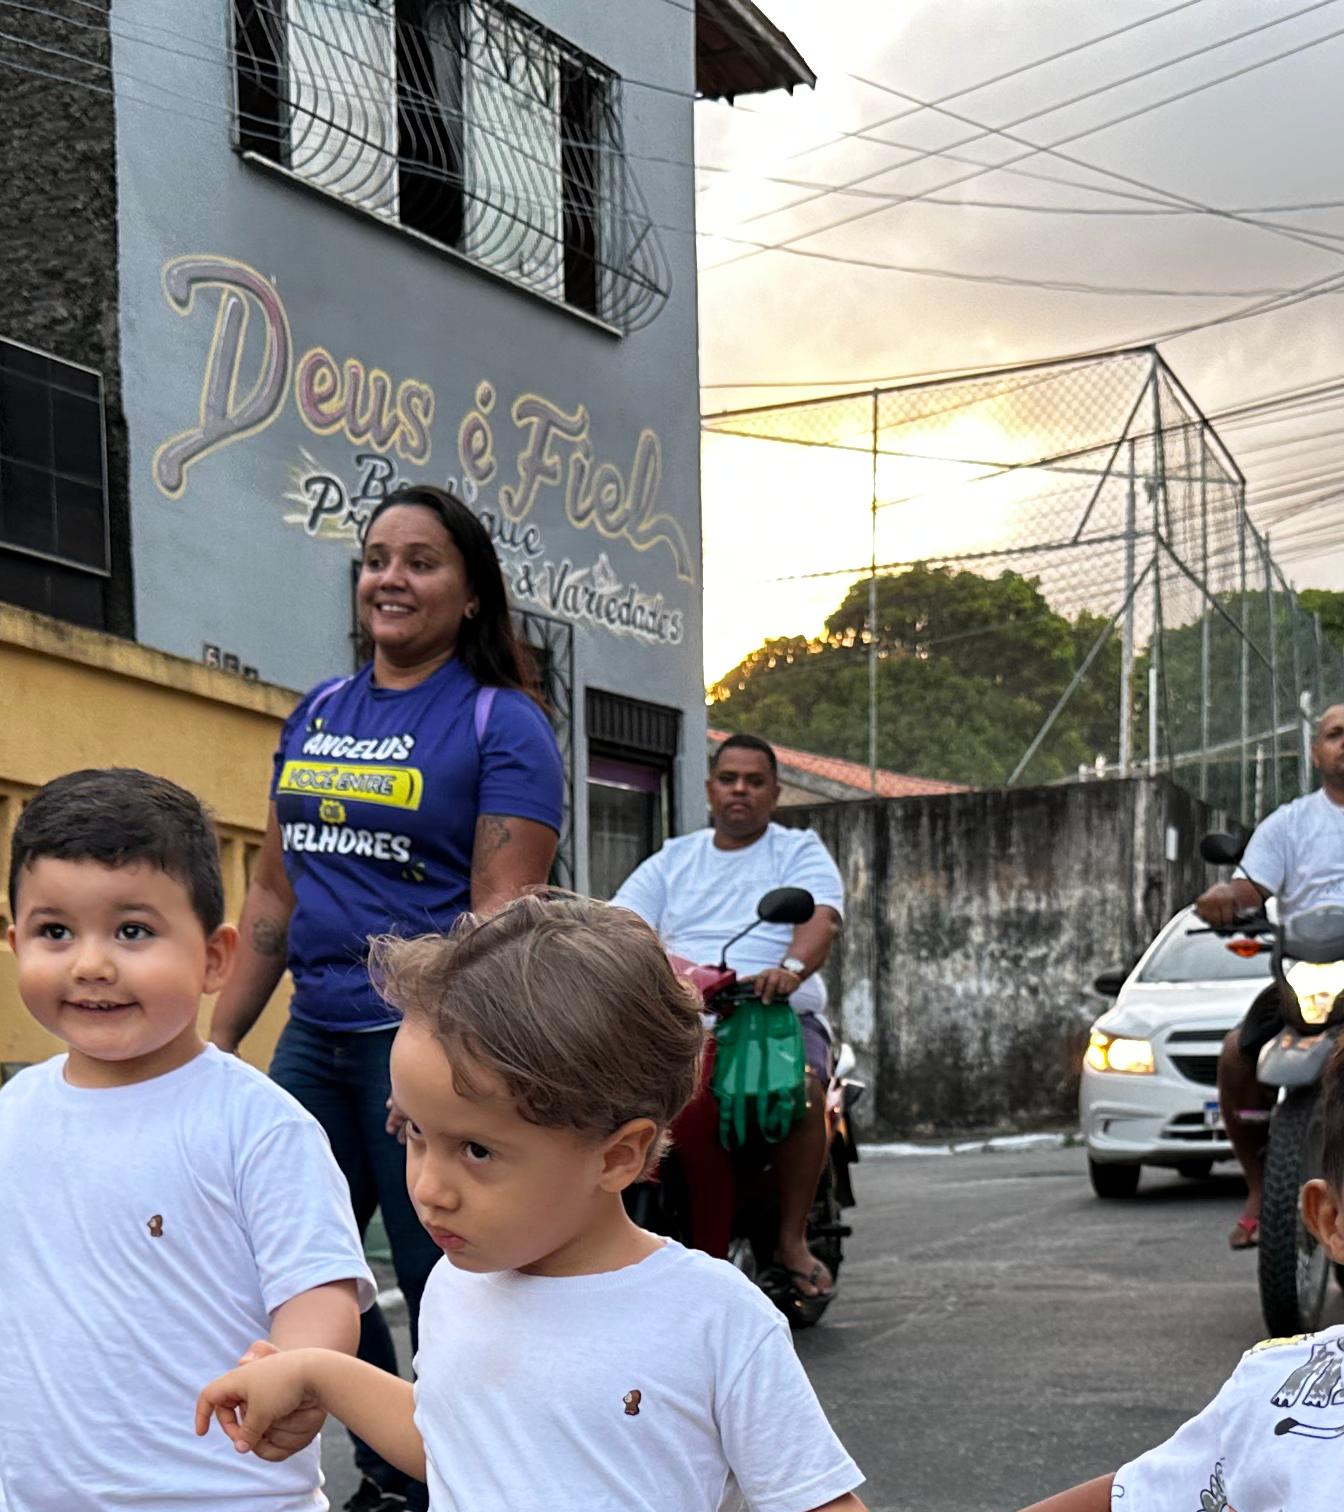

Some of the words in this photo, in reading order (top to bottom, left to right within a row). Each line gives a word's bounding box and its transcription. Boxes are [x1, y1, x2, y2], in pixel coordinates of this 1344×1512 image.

[157, 253, 436, 500] Deus
[499, 393, 694, 584] Fiel
[544, 558, 683, 644] Variedades
[302, 732, 415, 760] ANGELUS
[280, 821, 412, 863] MELHORES
